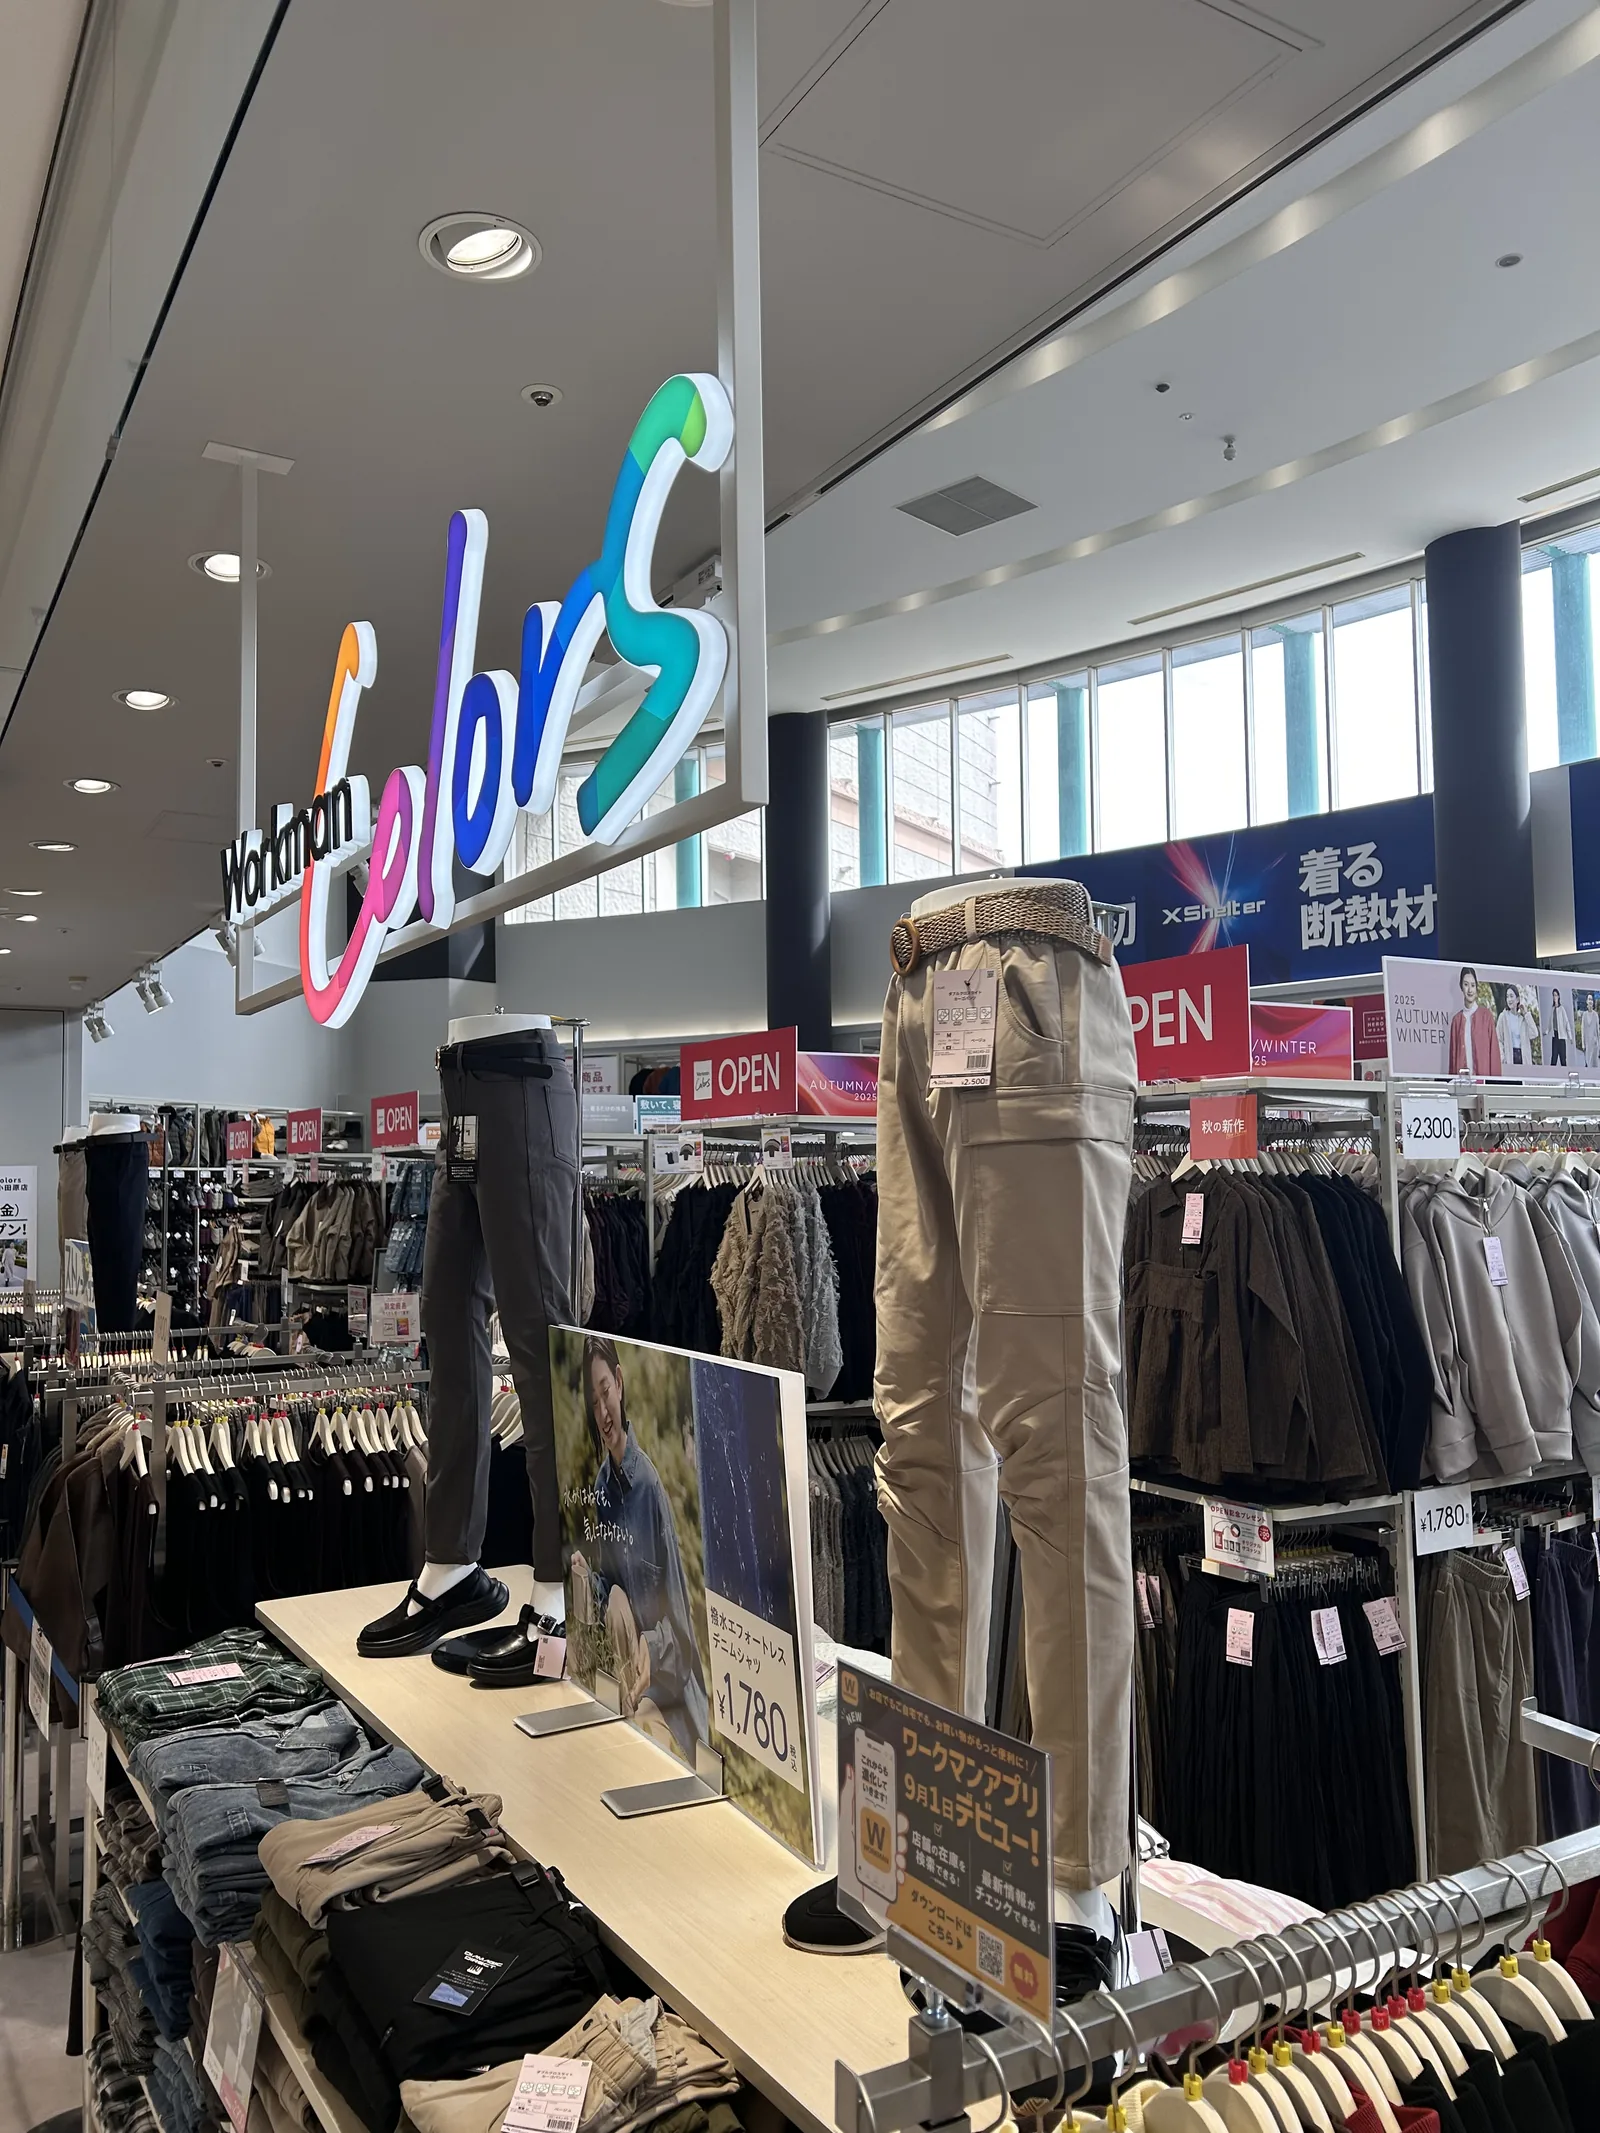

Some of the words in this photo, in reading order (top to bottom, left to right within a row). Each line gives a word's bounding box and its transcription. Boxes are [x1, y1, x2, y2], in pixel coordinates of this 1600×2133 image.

[299, 373, 733, 1028] Colors
[221, 776, 353, 921] Workman
[1299, 841, 1383, 897] 着る
[1301, 884, 1438, 950] 断熱材
[1394, 994, 1415, 1006] 2025
[1129, 987, 1213, 1048] PEN
[1395, 1008, 1449, 1026] AUTUMN
[1396, 1027, 1446, 1044] WINTER
[718, 1051, 780, 1096] OPEN
[1252, 1055, 1267, 1066] 25
[854, 1092, 877, 1101] 2025
[298, 1119, 318, 1142] OPEN
[386, 1105, 413, 1133] OPEN
[1201, 1119, 1245, 1135] 秋の新作
[1406, 1116, 1453, 1140] ¥2,300
[234, 1130, 249, 1149] OPEN
[584, 1516, 634, 1546] 気にならない。
[1420, 1503, 1465, 1533] ¥1,780
[713, 1632, 761, 1674] デニムシャツ
[716, 1672, 788, 1763] ¥1,780
[845, 1710, 862, 1725] NEW
[861, 1754, 889, 1777] これからも
[862, 1767, 888, 1792] 進化して
[903, 1727, 1038, 1818] ワークマンアプリ
[863, 1782, 888, 1805] いきます!
[866, 1818, 886, 1852] W
[904, 1773, 1039, 1867] 9月1日デビュー!
[912, 1830, 966, 1873] 店舗の在庫を
[915, 1849, 960, 1888] 検索できる!
[982, 1869, 1036, 1912] 最新情報が
[911, 1889, 972, 1938] ダウンロードは
[975, 1885, 1041, 1935] チェックできる!
[928, 1919, 954, 1946] こちら
